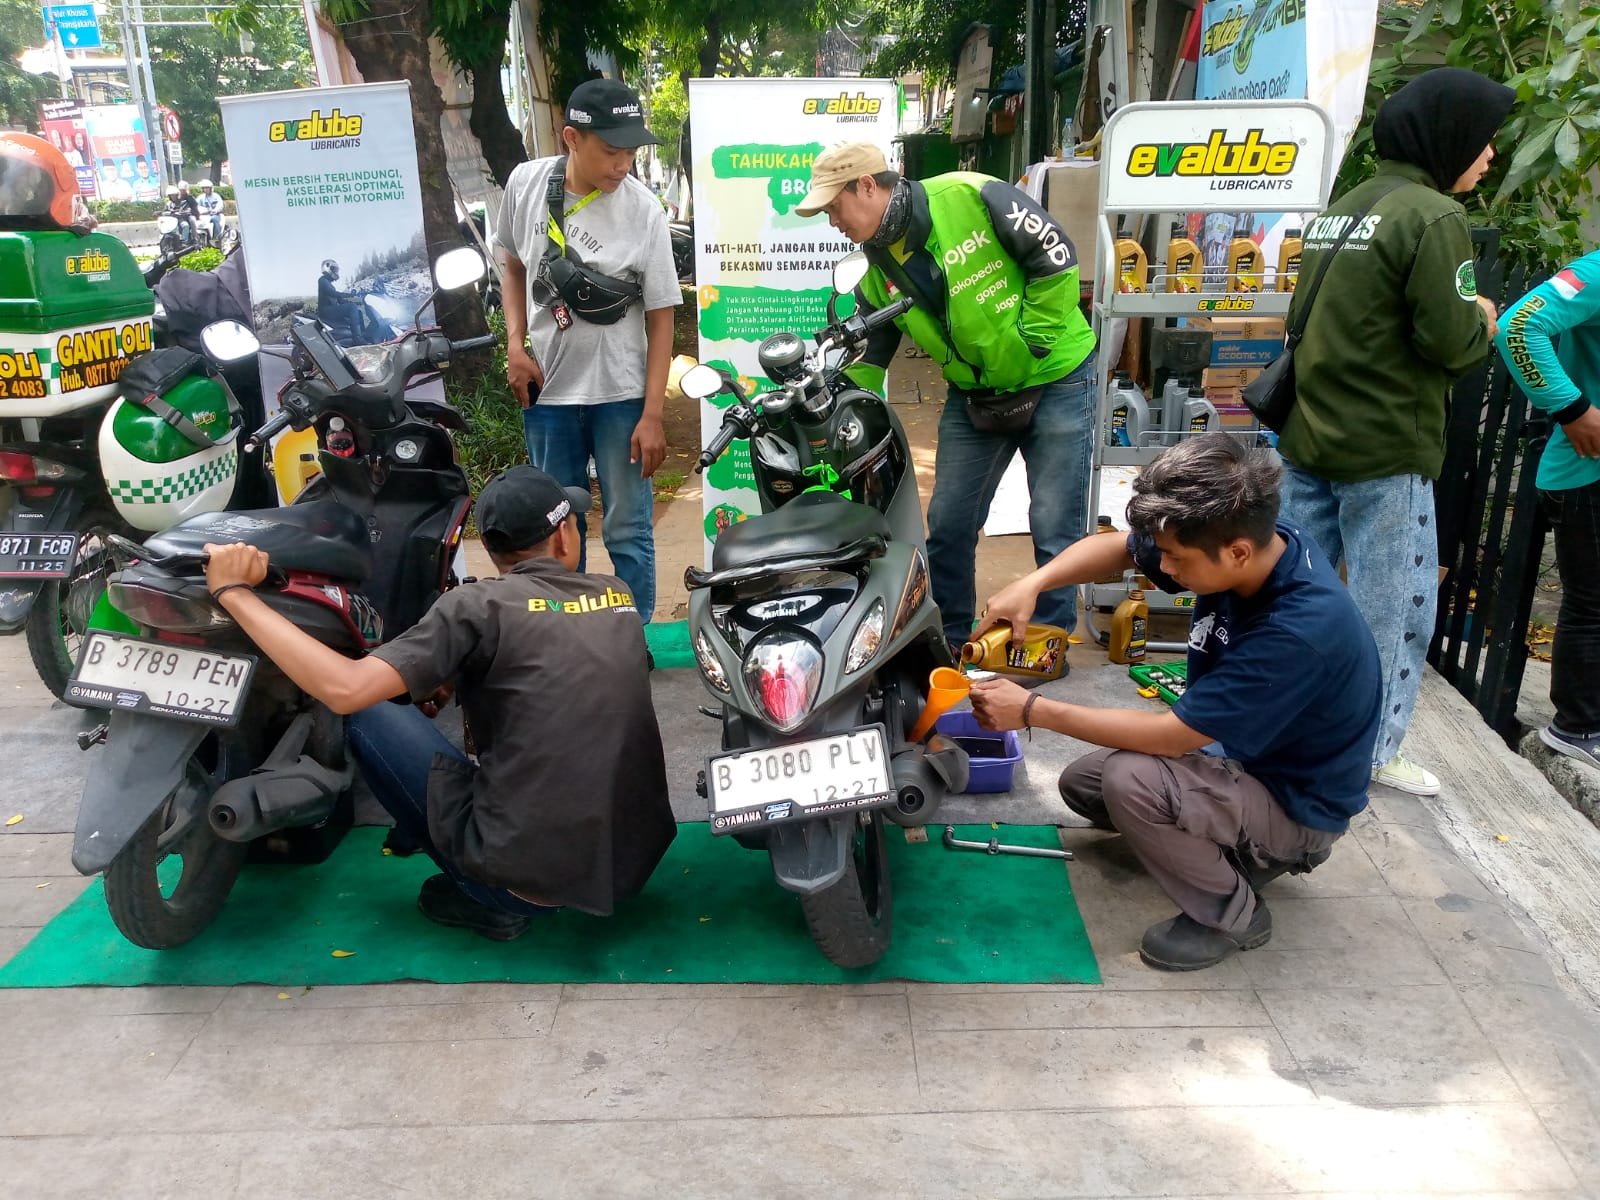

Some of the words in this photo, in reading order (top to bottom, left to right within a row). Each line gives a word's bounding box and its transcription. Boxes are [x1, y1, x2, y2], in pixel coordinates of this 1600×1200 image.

[803, 92, 881, 115] evalube
[270, 108, 362, 142] evalube
[311, 138, 360, 150] LUBRICANTS
[1126, 129, 1299, 177] evalube
[730, 153, 814, 168] TAHUKAH
[244, 177, 280, 188] MESIN
[284, 175, 321, 186] BERSIH
[325, 170, 402, 182] TERLINDUNGI,
[286, 184, 352, 196] AKSELERASI
[354, 180, 404, 192] OPTIMAL
[1210, 180, 1293, 190] LUBRICANTS
[288, 196, 316, 208] BIKIN
[320, 195, 342, 205] IRIT
[344, 192, 404, 203] MOTORMU!
[568, 224, 579, 238] TO
[580, 232, 604, 254] RIDE
[1005, 201, 1070, 266] gojek
[705, 244, 766, 254] HATI-HATI,
[770, 243, 815, 253] JANGAN
[818, 242, 856, 252] BUANG
[944, 230, 992, 275] ojek
[66, 248, 110, 274] evalube
[720, 260, 773, 271] BEKASMU
[976, 276, 1008, 304] gopay
[995, 294, 1019, 314] Jago
[1198, 296, 1254, 311] evalube
[58, 328, 118, 367] GANTI
[121, 322, 151, 354] OLI
[1506, 294, 1548, 388] ANNIVERSARY
[60, 369, 84, 393] Hub.
[86, 362, 108, 387] 0877
[12, 380, 44, 396] 4083
[40, 538, 72, 554] FCB
[528, 587, 632, 614] evalube
[762, 608, 798, 620] YAMAHA
[88, 640, 106, 664] B
[117, 646, 178, 676] 3789
[193, 658, 244, 688] PEN
[80, 688, 114, 702] YAMAHA
[150, 706, 190, 716] SEMAKIN
[201, 714, 230, 722] DEPAN
[718, 764, 732, 791] B
[750, 750, 812, 782] 3080
[829, 736, 876, 768] PLV
[804, 802, 846, 814] SEMAKIN
[858, 795, 890, 806] DEPAN
[725, 811, 762, 826] YAMAHA
